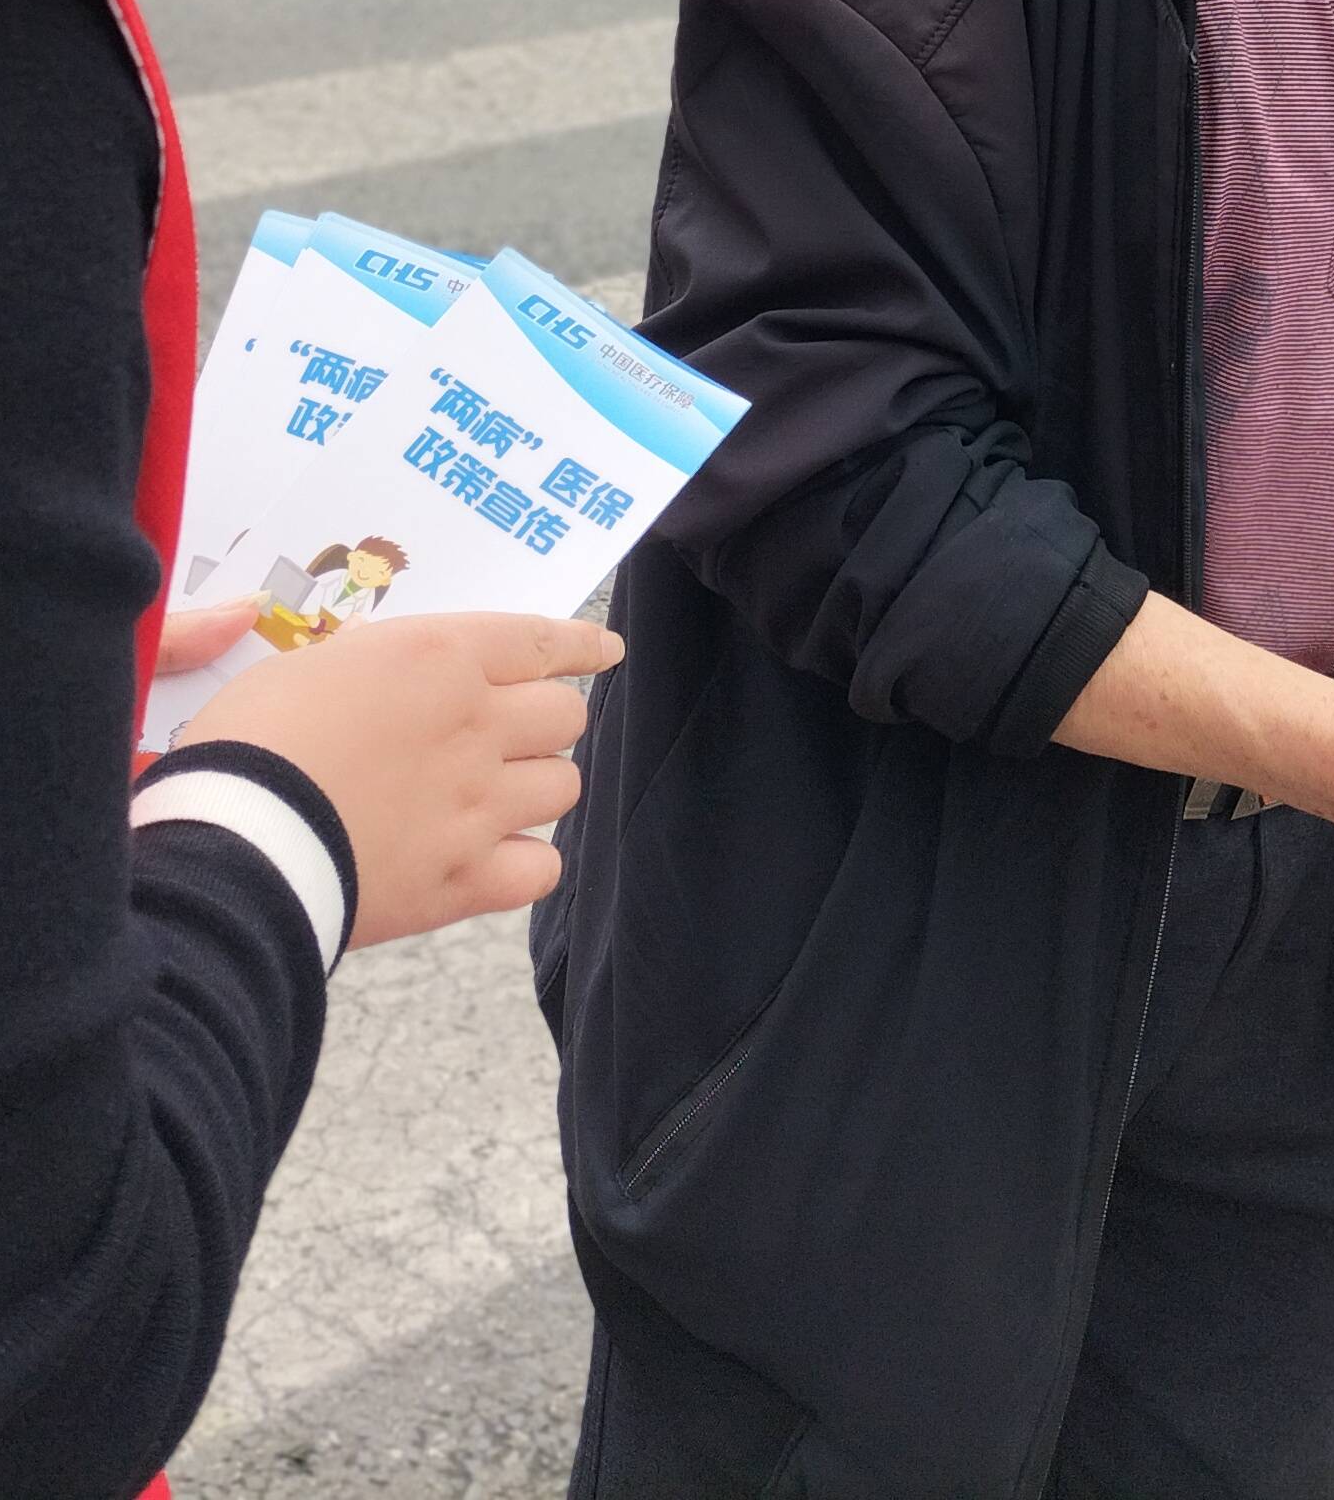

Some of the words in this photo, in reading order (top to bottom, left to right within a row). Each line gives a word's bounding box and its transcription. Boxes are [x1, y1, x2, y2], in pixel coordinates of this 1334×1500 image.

[354, 249, 439, 292] CHS
[516, 293, 598, 350] CHS
[599, 343, 697, 410] 中国医疗保障
[285, 396, 354, 447] 政
[402, 425, 572, 556] 政策宣传
